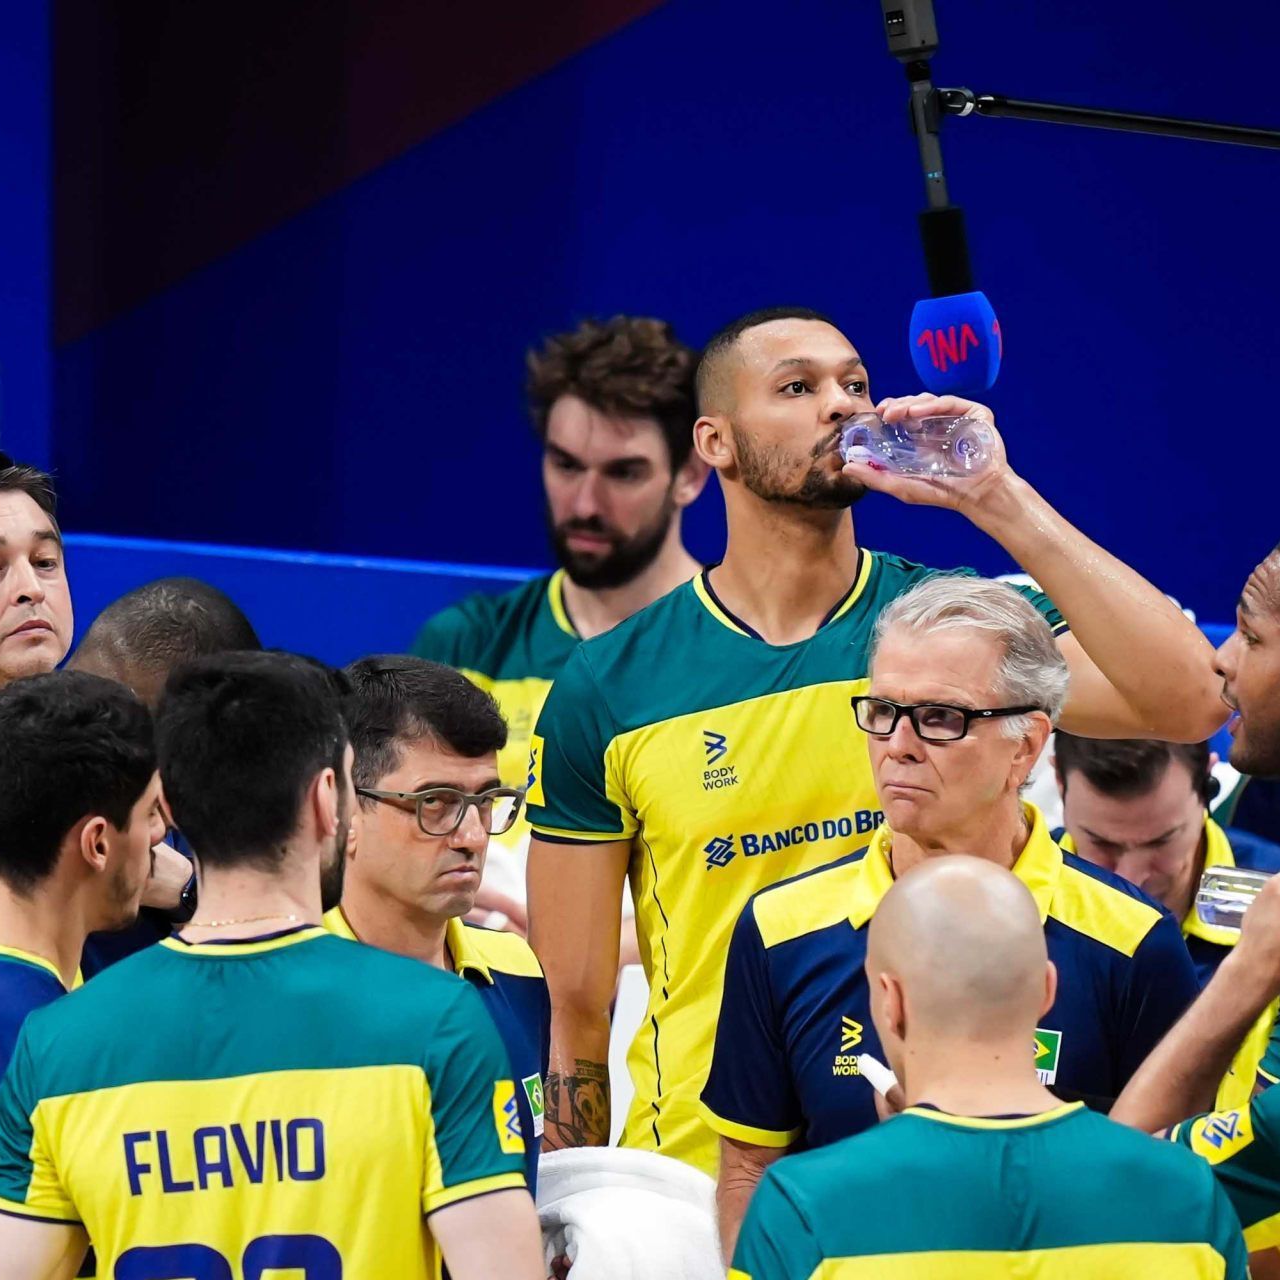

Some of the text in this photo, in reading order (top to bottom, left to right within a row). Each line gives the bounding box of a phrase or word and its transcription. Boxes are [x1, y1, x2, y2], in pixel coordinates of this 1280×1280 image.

[703, 766, 735, 781] BODY
[702, 775, 739, 791] WORK
[740, 822, 819, 857] BANCO
[823, 817, 852, 839] DO
[835, 1055, 859, 1066] BOD
[123, 1117, 326, 1196] FLAVIO
